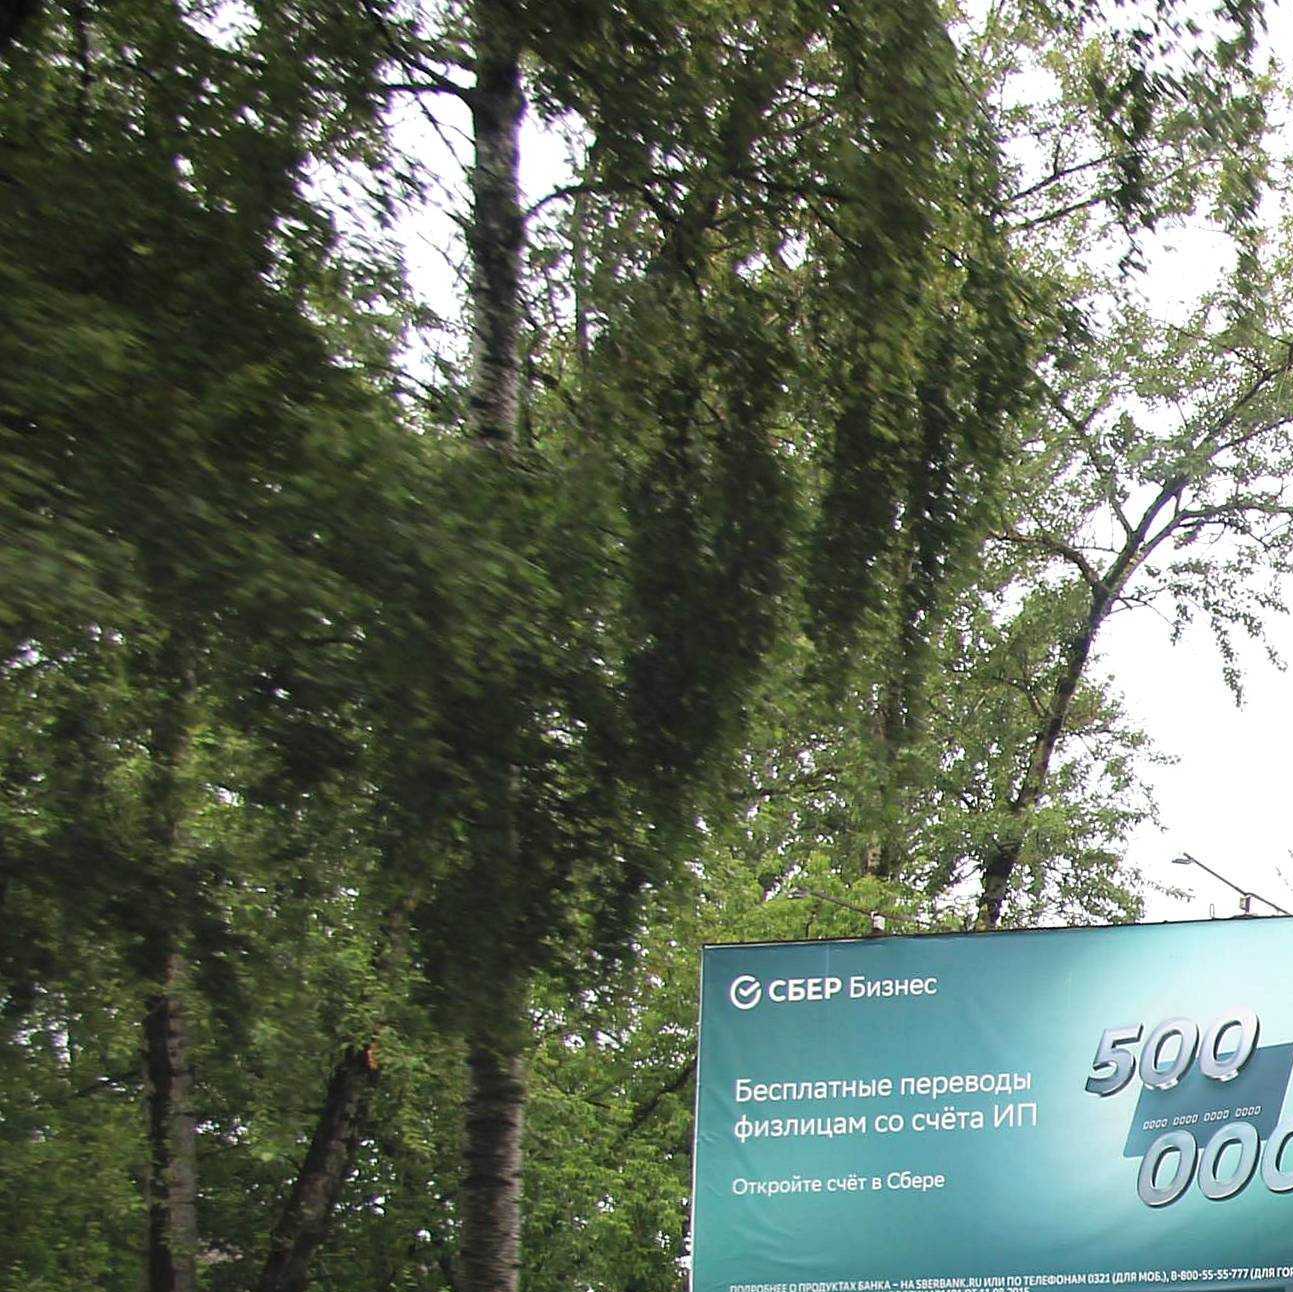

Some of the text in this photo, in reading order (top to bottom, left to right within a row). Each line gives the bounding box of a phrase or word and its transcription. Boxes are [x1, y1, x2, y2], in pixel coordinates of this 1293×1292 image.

[769, 975, 939, 1002] СБЕР Бизнес
[1084, 1005, 1261, 1098] 500
[735, 1072, 1032, 1102] Бесплатные переводы
[734, 1103, 1038, 1143] физлицам со счёта ИП
[732, 1171, 946, 1197] Откройте счёт в Сбере
[789, 1283, 797, 1292] О
[799, 1281, 857, 1292] ПРОДУКТАХ
[858, 1280, 890, 1291] БАНКА
[900, 1279, 915, 1289] НА
[916, 1277, 981, 1290] SBERBANK.RU
[984, 1276, 1005, 1287] ИЛИ
[1007, 1276, 1022, 1286] ПО
[1024, 1273, 1087, 1286] ТЕЛЕФОНАМ
[1112, 1271, 1137, 1284] (ДЛЯ
[1171, 1268, 1249, 1282] 8-800-55-55-777
[1250, 1267, 1275, 1280] (ДЛЯ
